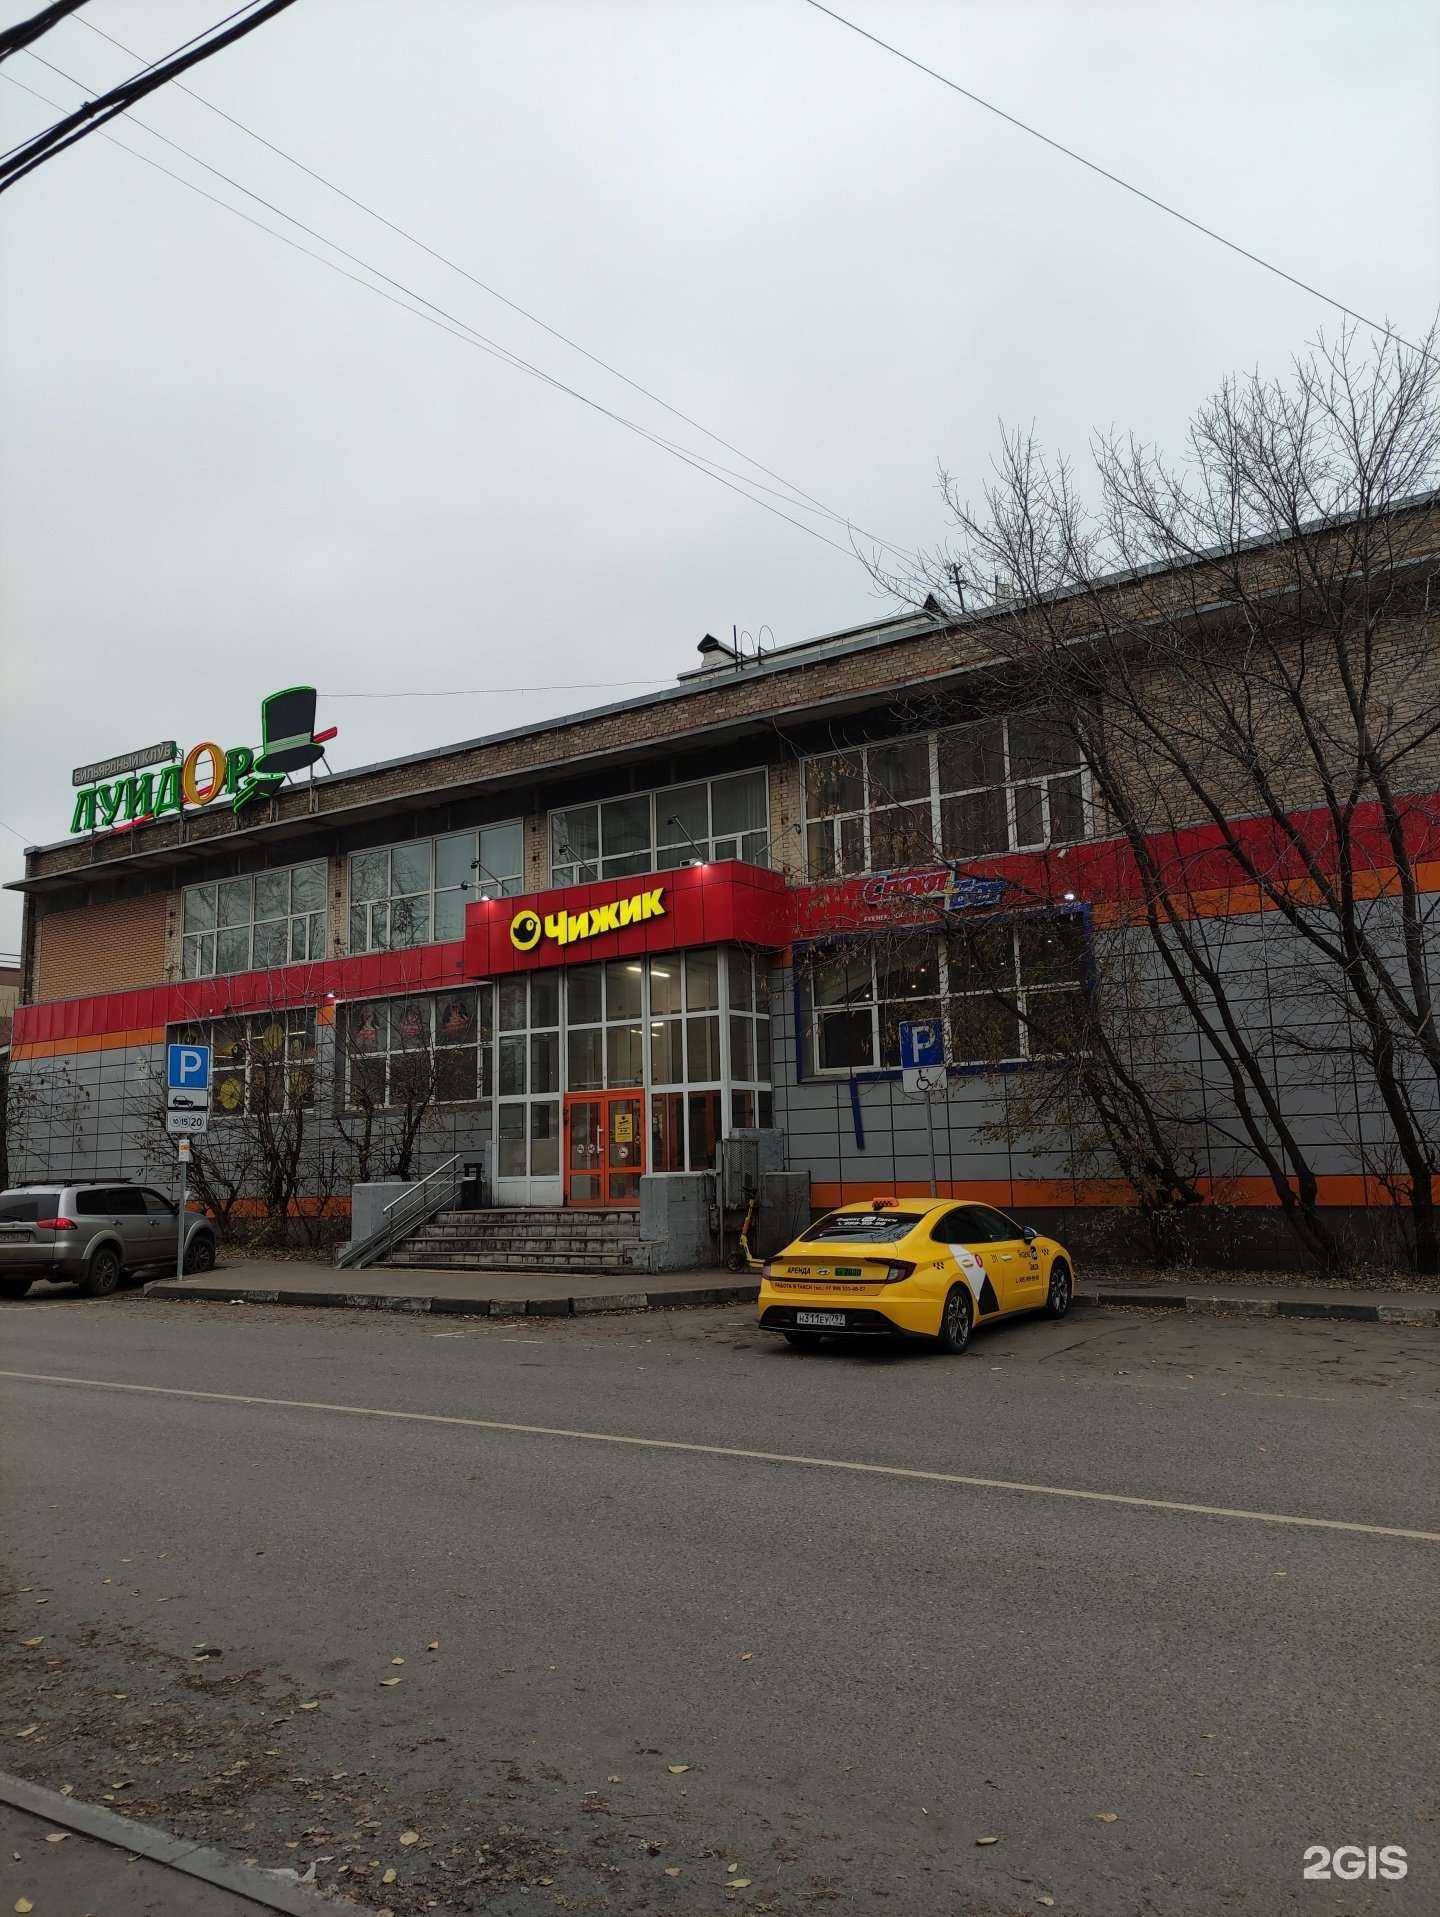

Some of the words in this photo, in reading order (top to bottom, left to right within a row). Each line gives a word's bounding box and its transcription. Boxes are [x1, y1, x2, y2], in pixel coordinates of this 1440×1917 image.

[74, 755, 140, 782] БИЛЬЯРДНЫЙ
[143, 743, 171, 763] КЛУБ
[70, 741, 254, 834] ЛУИДОР
[180, 1050, 202, 1084] P
[180, 1117, 188, 1126] 15
[190, 1117, 202, 1127] 20
[787, 1266, 811, 1275] АРЕНДА
